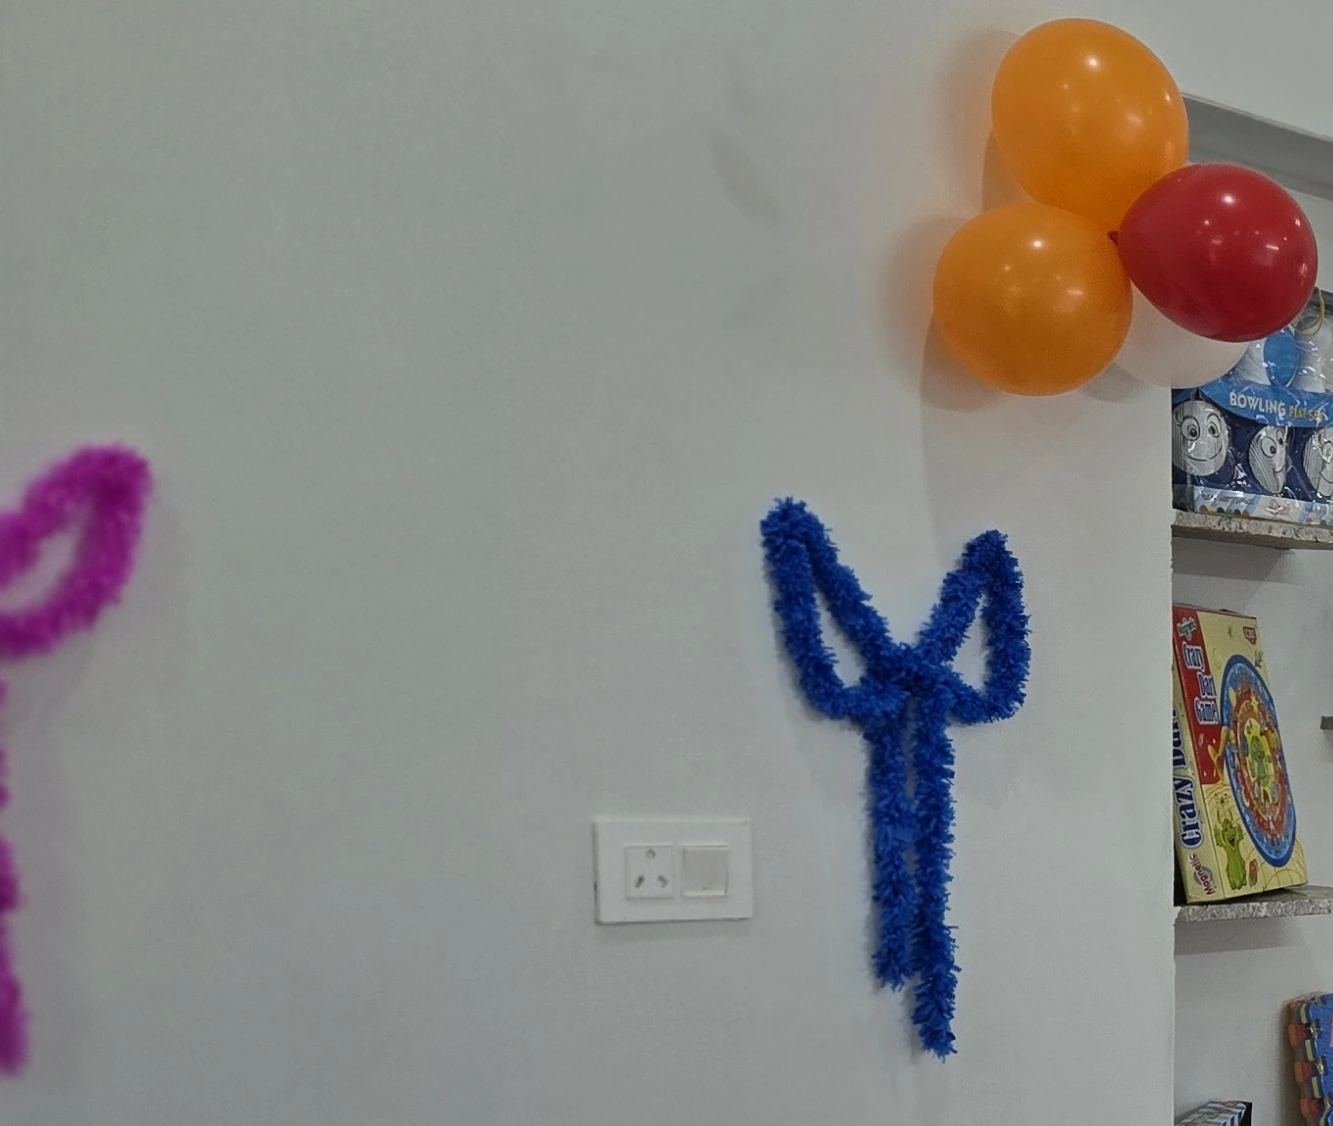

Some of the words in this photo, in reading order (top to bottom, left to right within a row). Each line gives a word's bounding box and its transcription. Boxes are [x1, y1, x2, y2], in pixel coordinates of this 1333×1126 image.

[1229, 391, 1286, 417] BOWLING
[1182, 641, 1205, 672] Crazy
[1195, 697, 1220, 725] Game
[1173, 775, 1203, 849] Crazy
[1189, 854, 1215, 896] Magnetic
